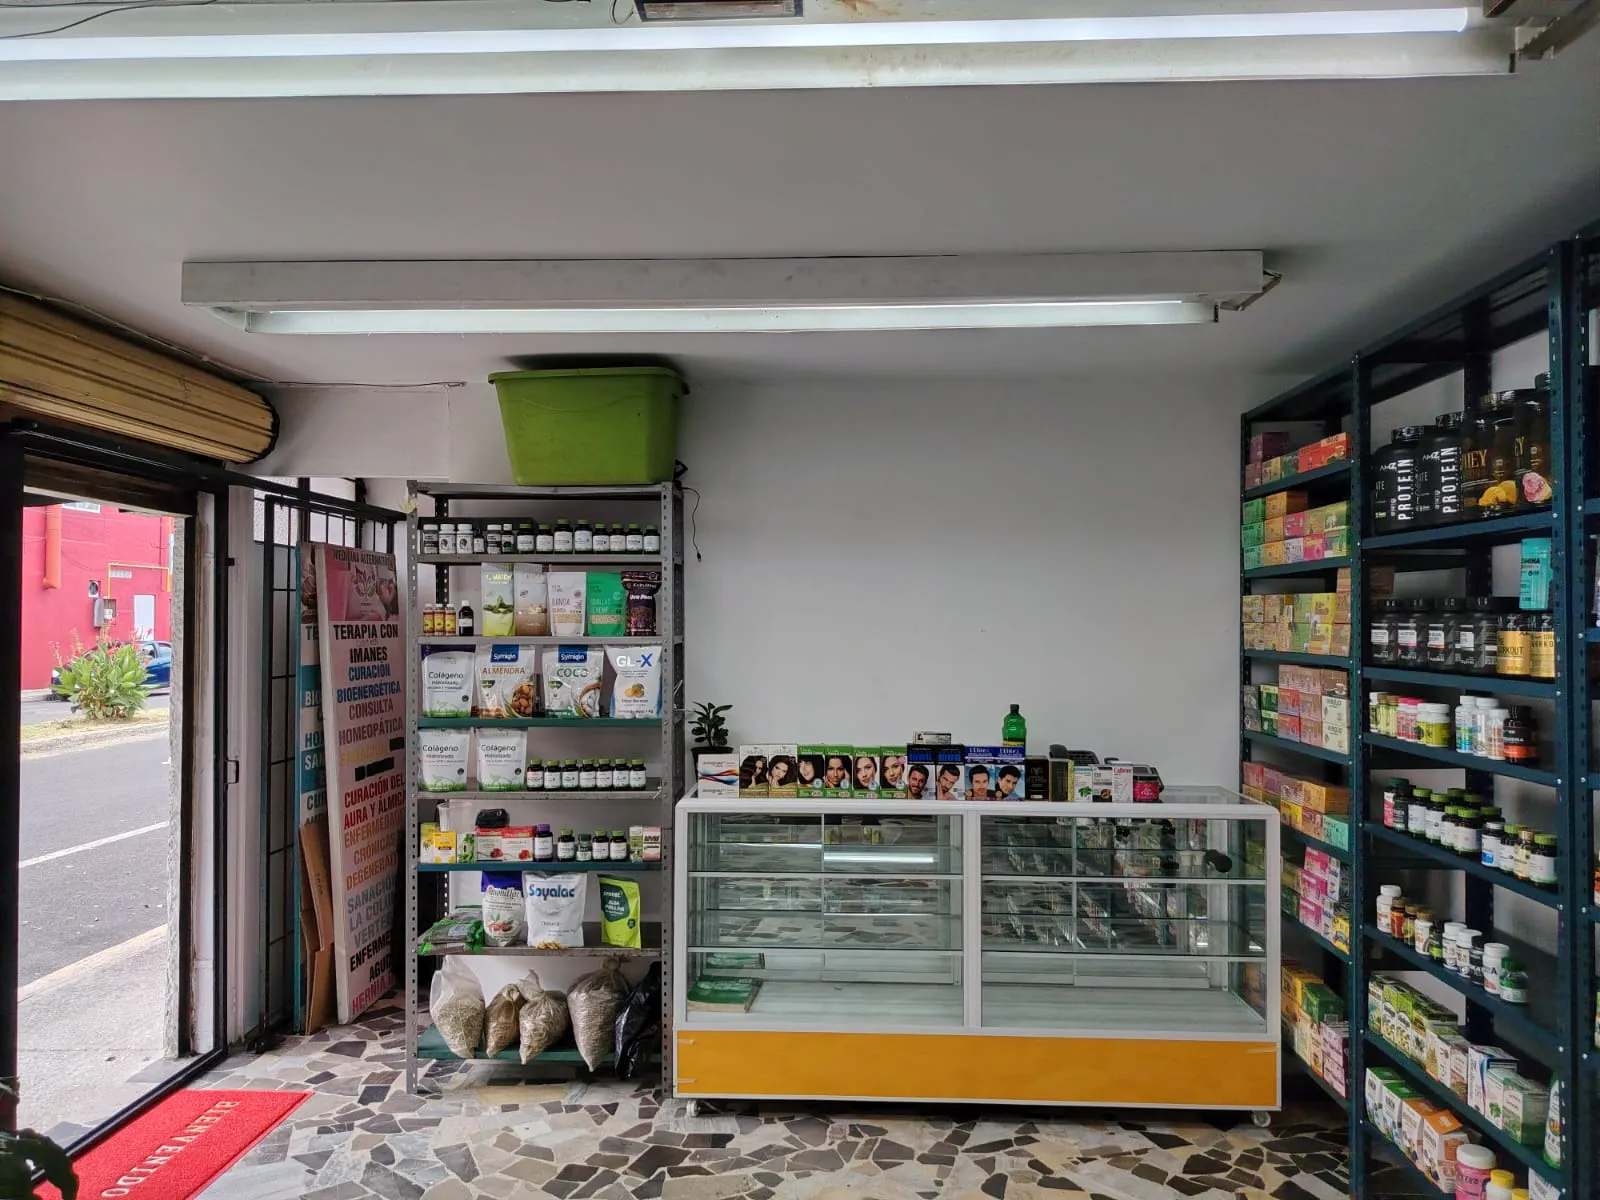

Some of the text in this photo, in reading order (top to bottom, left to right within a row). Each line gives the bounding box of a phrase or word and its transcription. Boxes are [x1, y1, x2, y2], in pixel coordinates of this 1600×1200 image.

[1397, 458, 1413, 521] PROTEIN
[1440, 446, 1457, 514] PROTEIN
[333, 624, 398, 640] TERAPIA CON
[350, 647, 388, 664] IMANES
[348, 662, 391, 682] CURACIÓN
[428, 672, 464, 680] Colágeno
[482, 667, 525, 675] ALMENDRA
[556, 668, 588, 678] COCO
[337, 680, 402, 704] BIOENERGÉTICA
[349, 698, 394, 721] CONSULTA
[338, 716, 403, 746] HOMEOPÁTICA
[422, 744, 459, 753] Colágeno
[481, 744, 516, 753] Colágeno
[344, 773, 405, 809] CURACIÓN DEL
[343, 806, 368, 831] AURA
[369, 802, 376, 818] Y
[529, 884, 575, 900] Soyalac
[102, 1100, 240, 1197] BIENVENIDO
